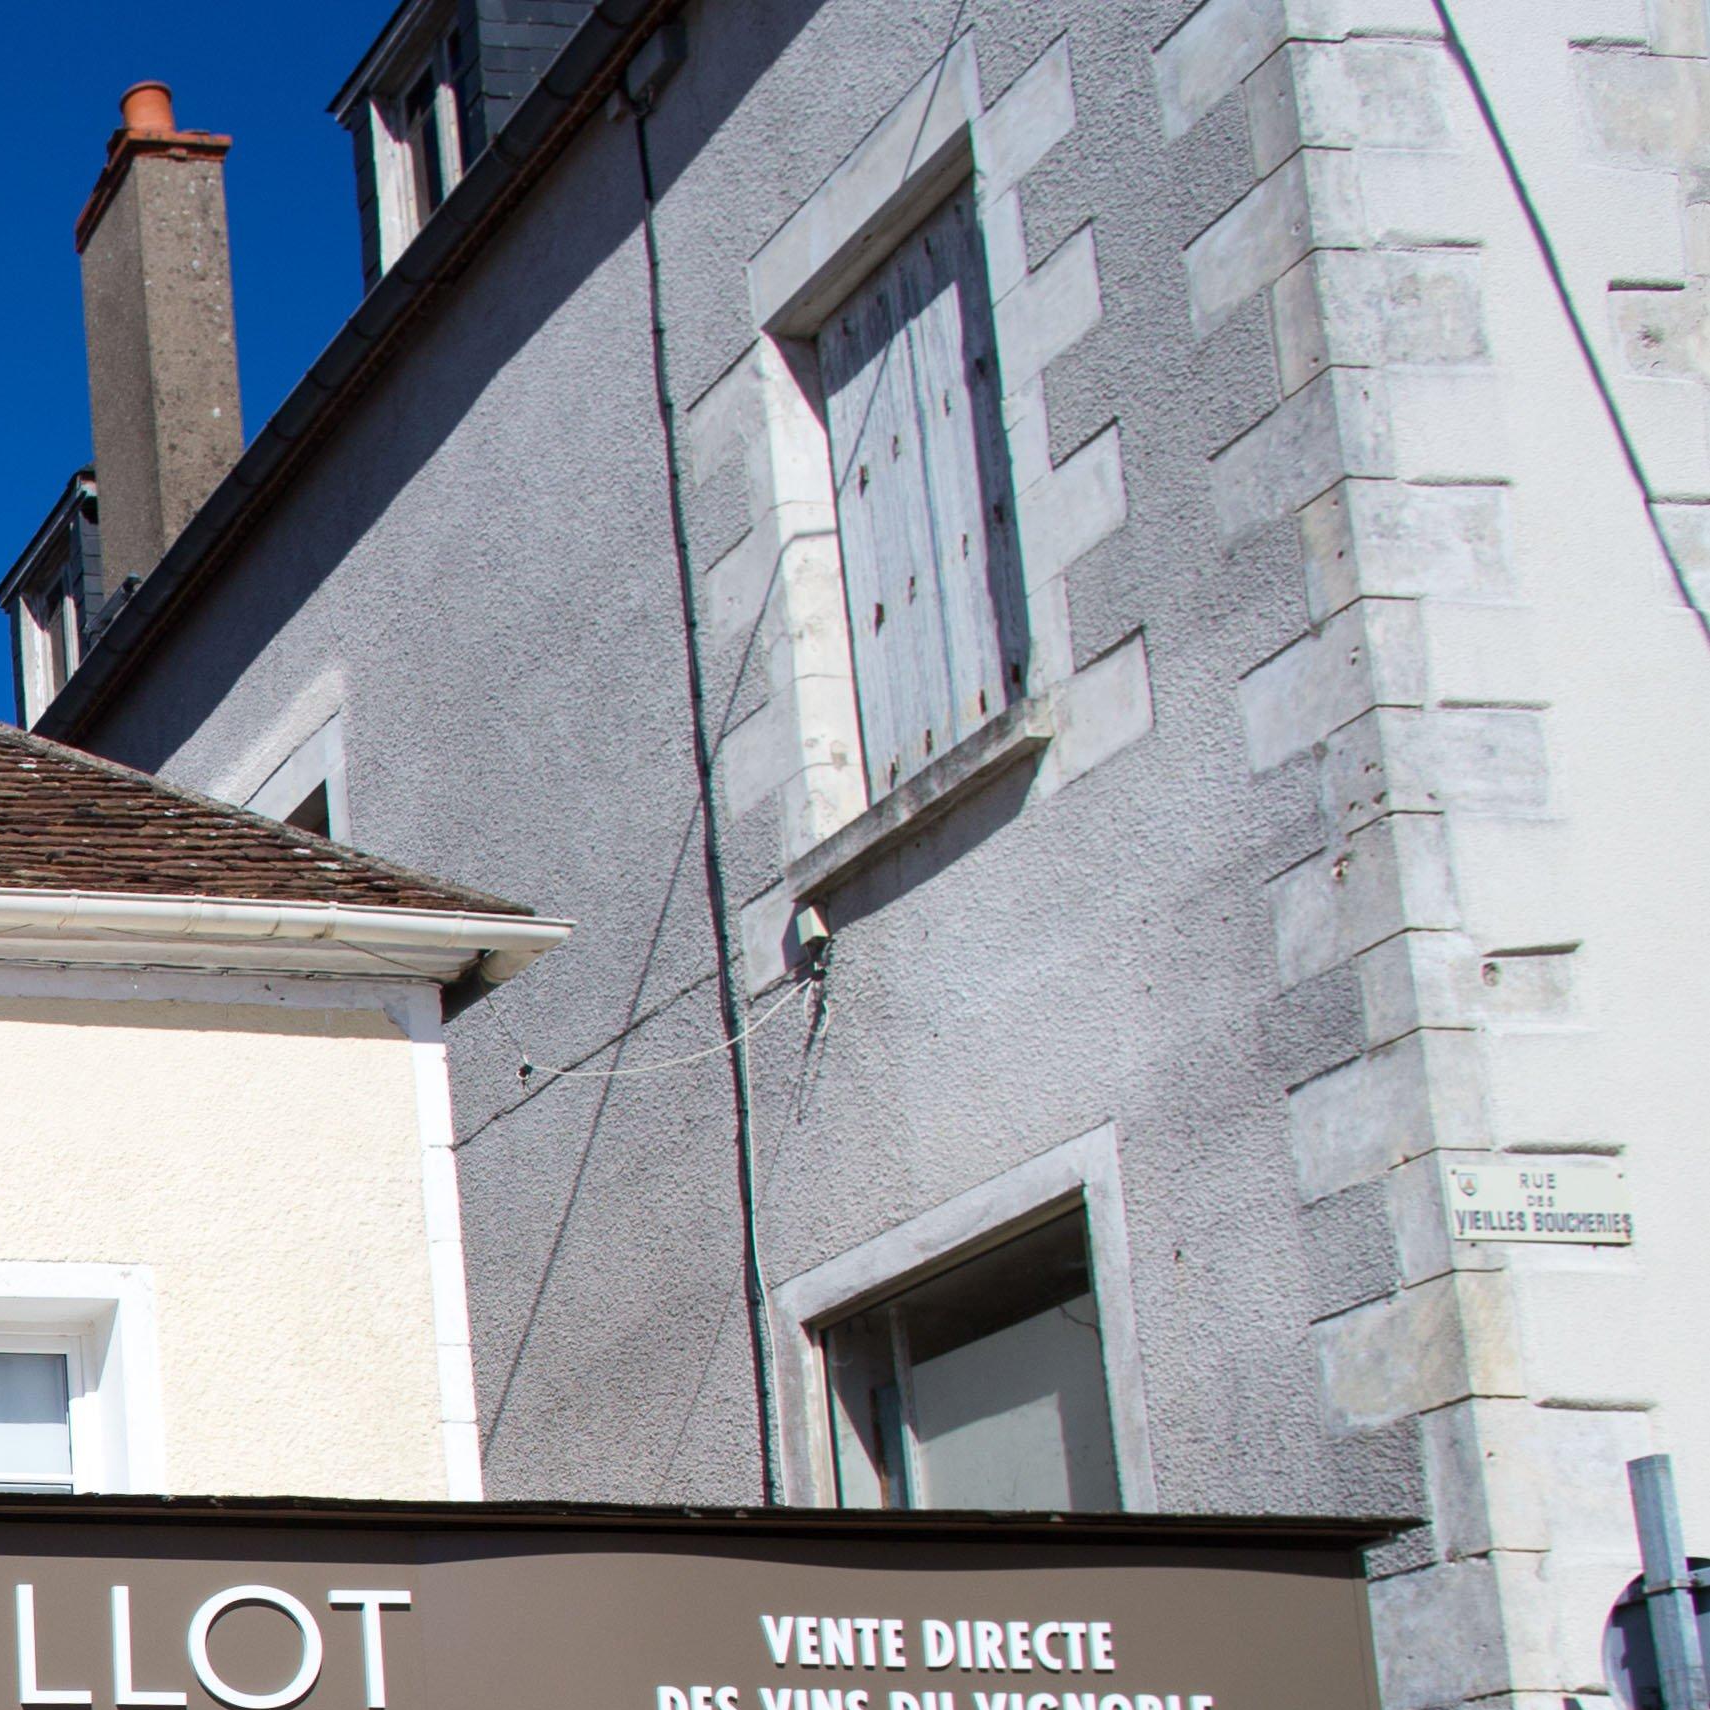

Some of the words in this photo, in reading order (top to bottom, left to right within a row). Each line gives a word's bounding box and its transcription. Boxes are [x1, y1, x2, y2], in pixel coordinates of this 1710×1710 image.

[1519, 1173, 1557, 1190] RUE
[1526, 1195, 1555, 1208] DES
[1455, 1210, 1528, 1232] VIEILLES
[1533, 1212, 1633, 1234] BOUCHERIES
[761, 1614, 907, 1668] VENTE
[922, 1618, 1116, 1671] DIRECTE
